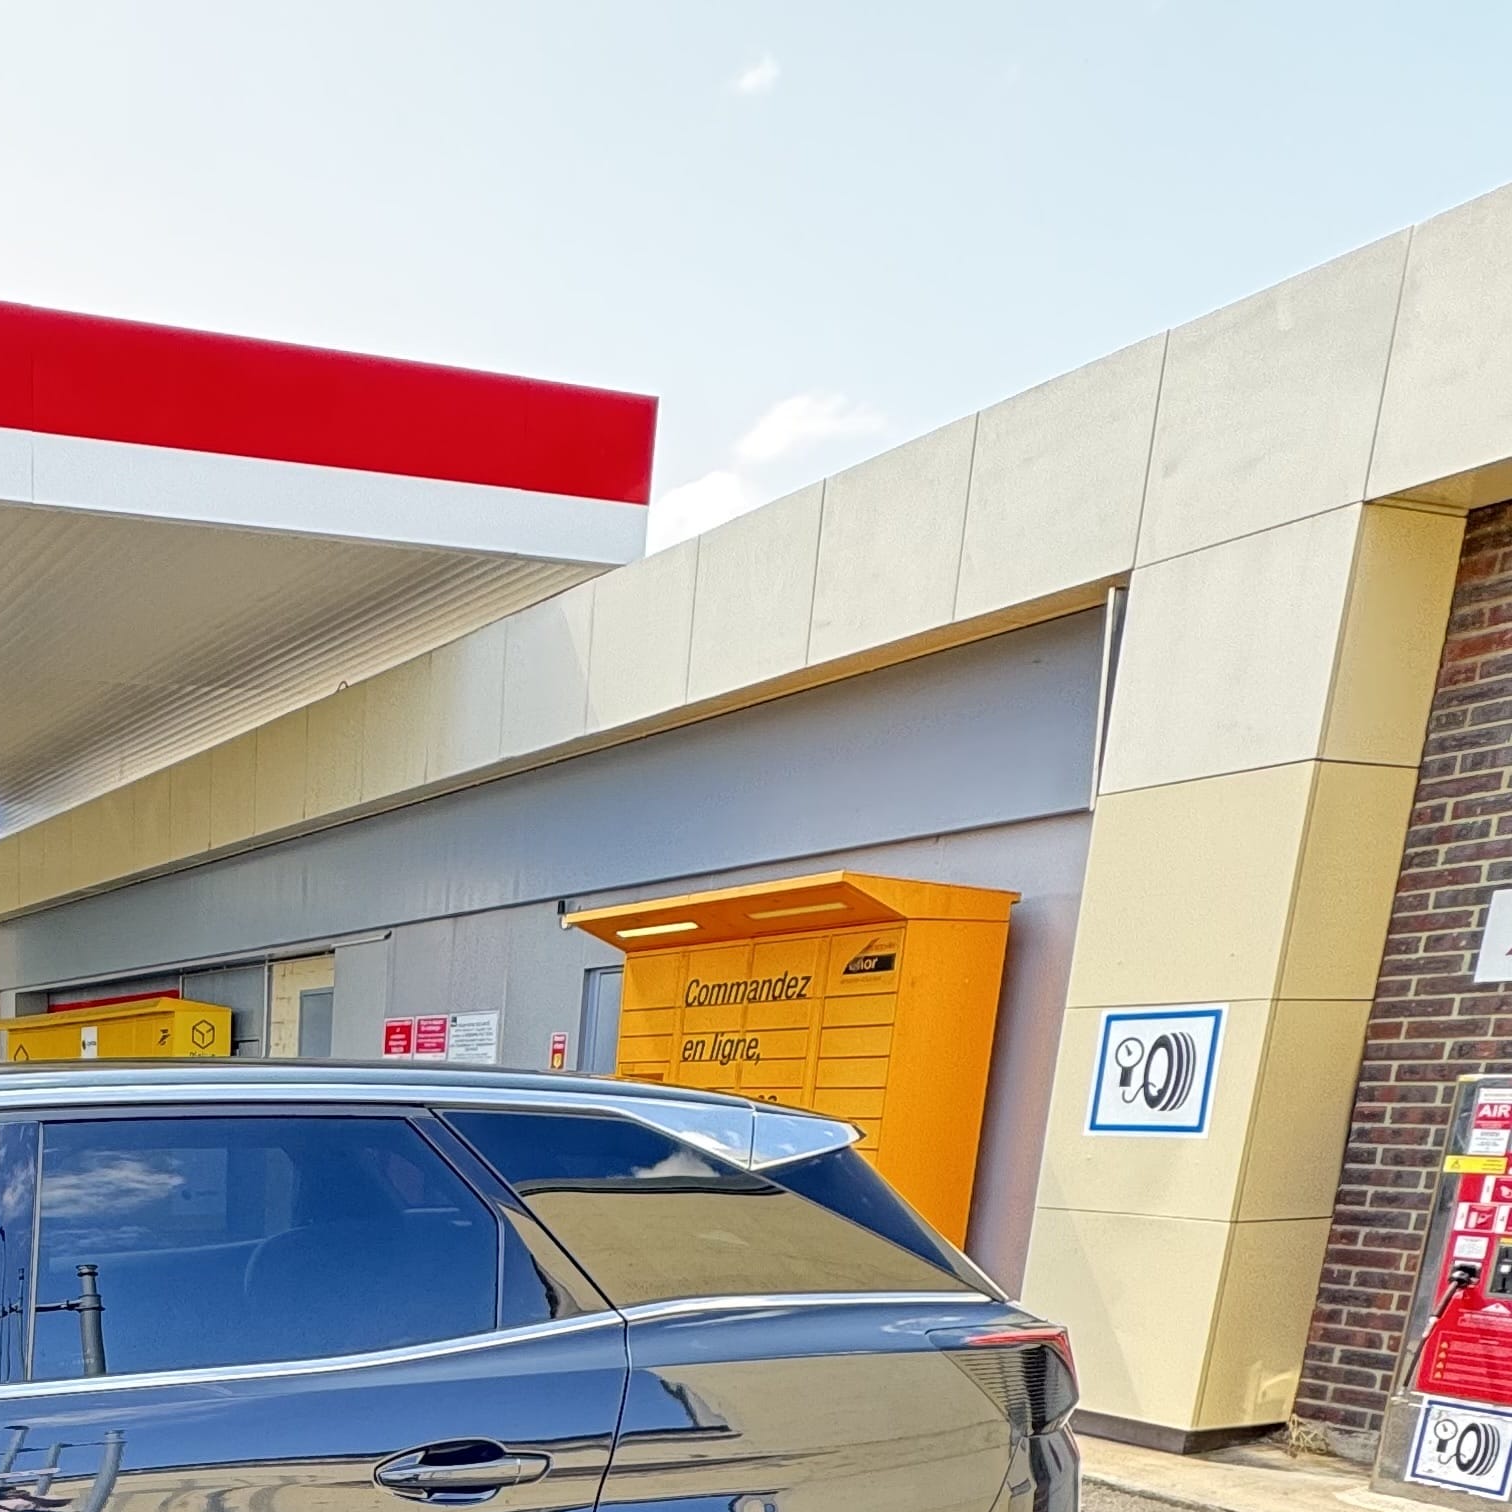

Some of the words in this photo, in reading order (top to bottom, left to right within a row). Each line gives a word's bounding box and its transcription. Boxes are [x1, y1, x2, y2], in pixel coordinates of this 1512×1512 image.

[685, 970, 813, 1008] Commandez
[682, 1037, 706, 1061] en
[710, 1032, 761, 1066] ligne,
[1478, 1104, 1511, 1119] AIR
